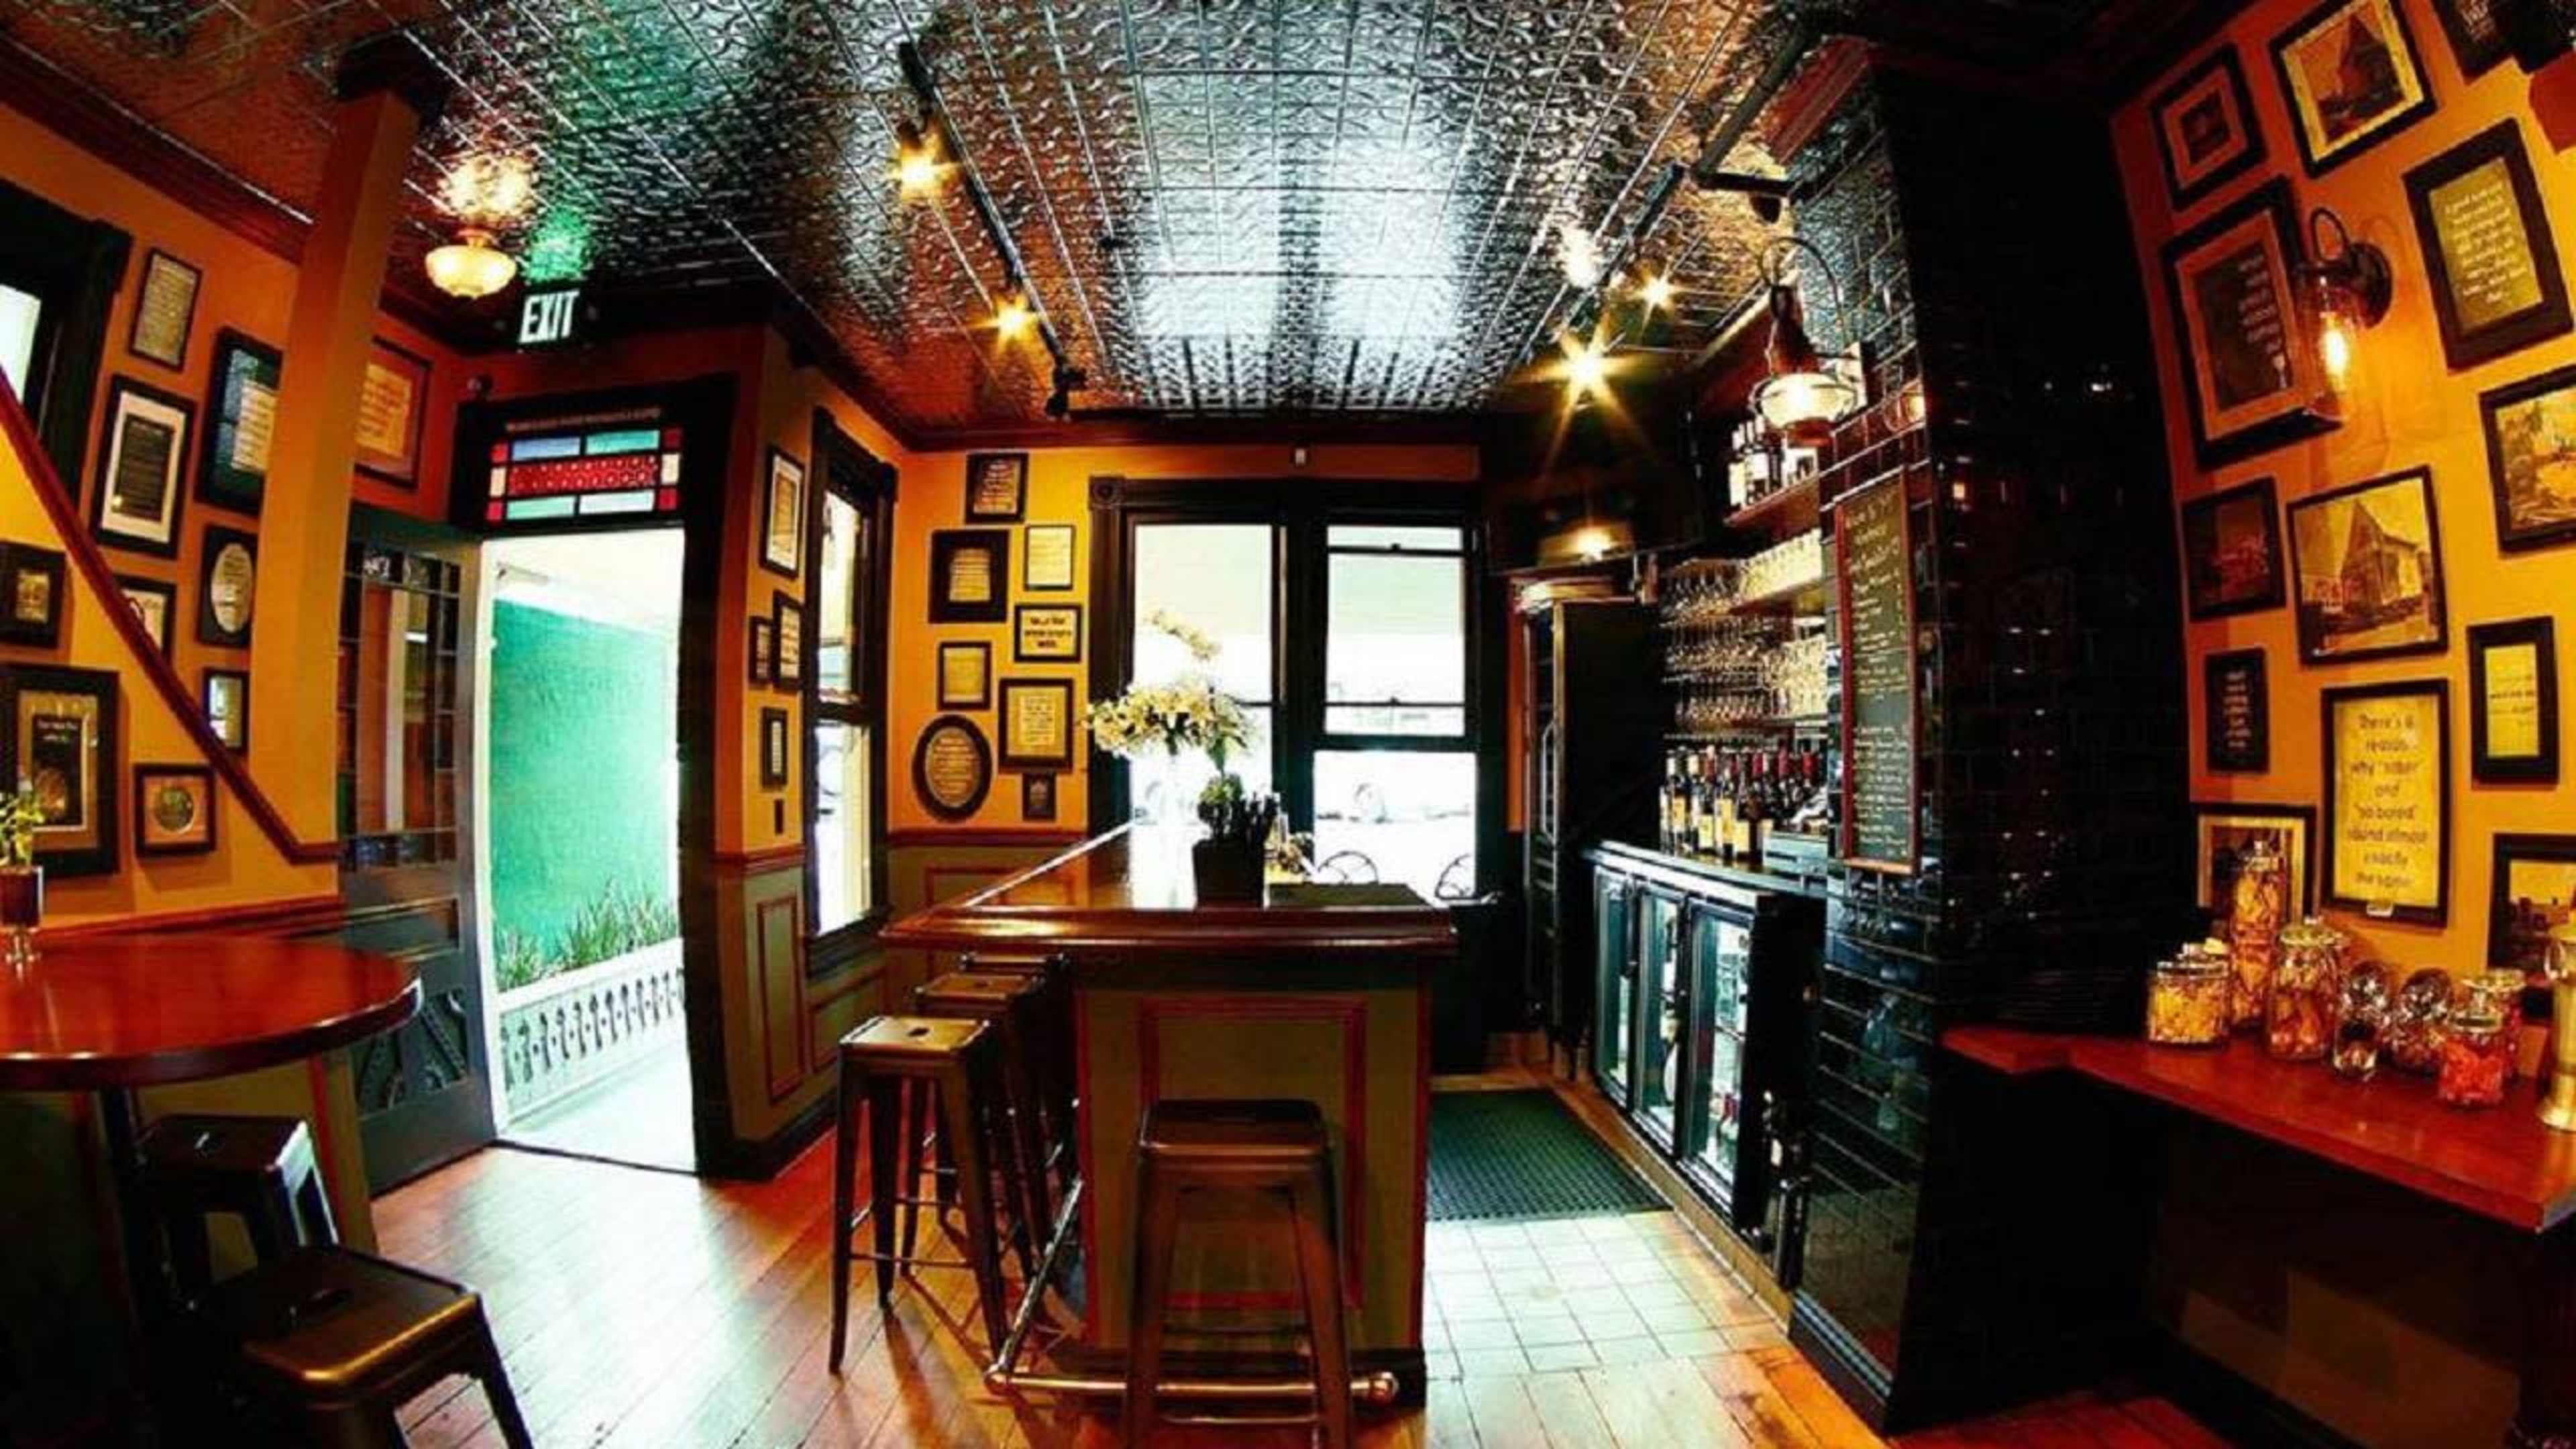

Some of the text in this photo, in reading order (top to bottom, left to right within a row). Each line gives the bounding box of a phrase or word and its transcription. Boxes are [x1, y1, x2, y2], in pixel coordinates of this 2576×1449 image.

[519, 289, 580, 343] EXIT
[2357, 712, 2402, 731] There's
[2365, 738, 2409, 753] reason
[2351, 761, 2375, 778] why
[2374, 780, 2400, 798] and
[2347, 825, 2428, 845] sound almost
[2362, 851, 2410, 870] exactly
